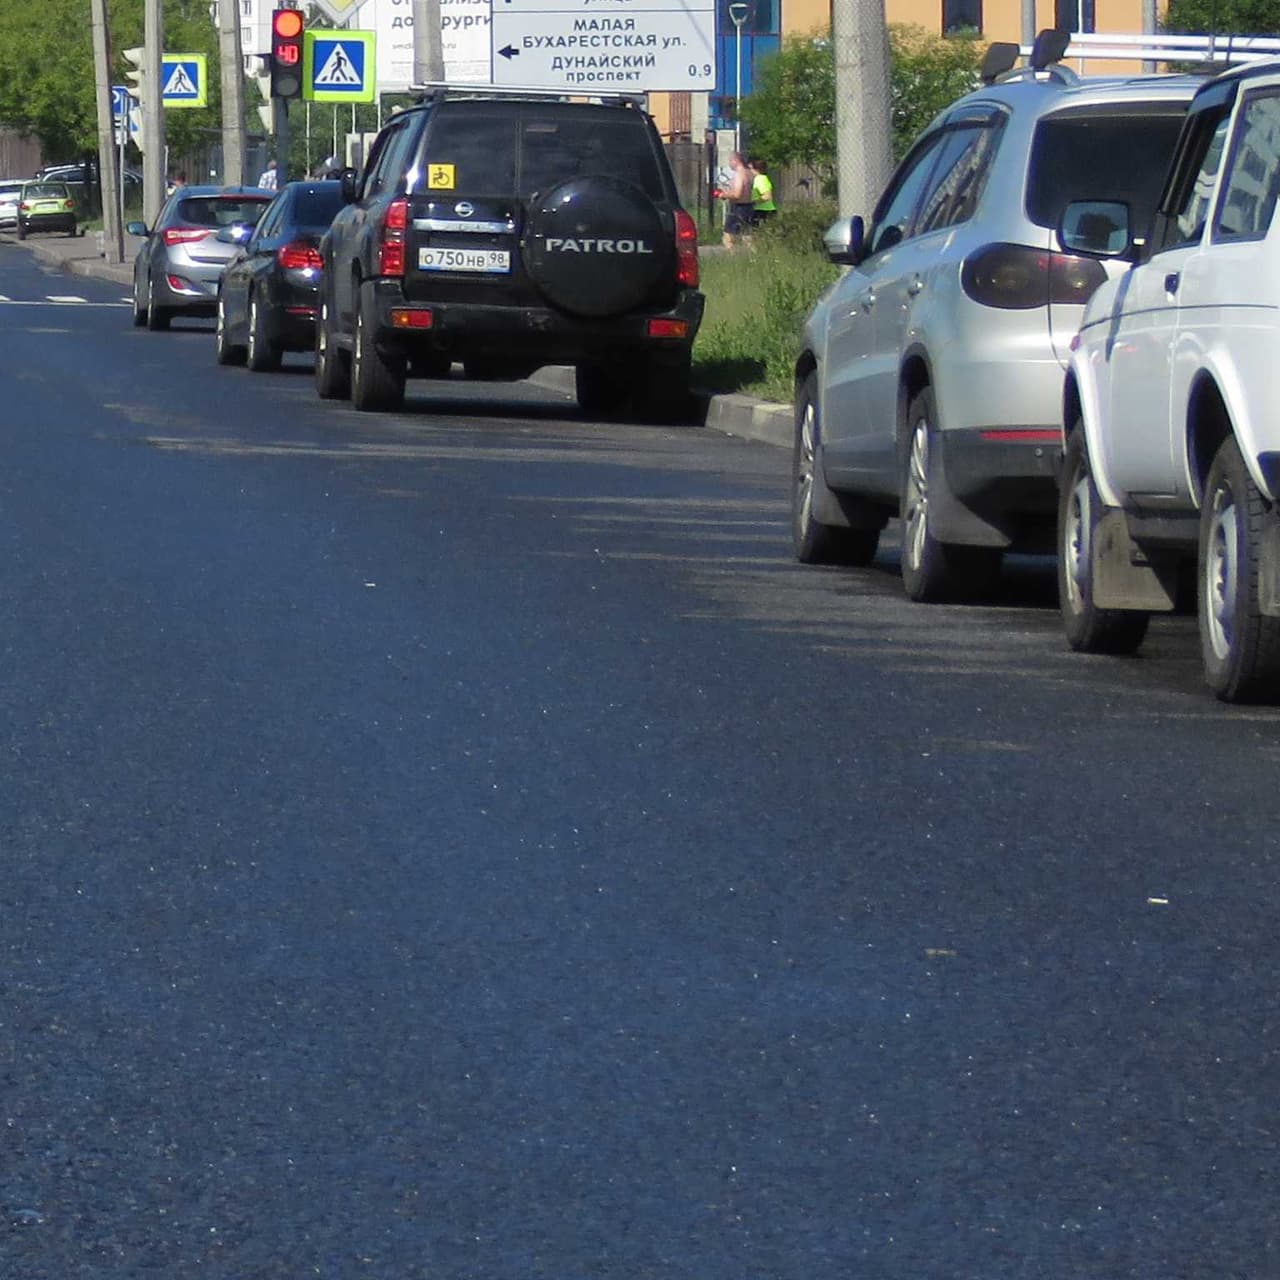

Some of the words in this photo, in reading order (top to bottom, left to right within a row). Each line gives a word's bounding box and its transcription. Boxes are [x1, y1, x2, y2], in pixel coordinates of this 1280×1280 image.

[573, 18, 635, 31] МАЛАЯ
[523, 34, 657, 49] БУХАРЕСТСКАЯ
[662, 36, 687, 49] ул.
[279, 45, 298, 62] 40
[552, 53, 656, 71] ДУНАЙСКИЙ
[566, 71, 641, 84] проспект
[545, 238, 653, 253] PATROL
